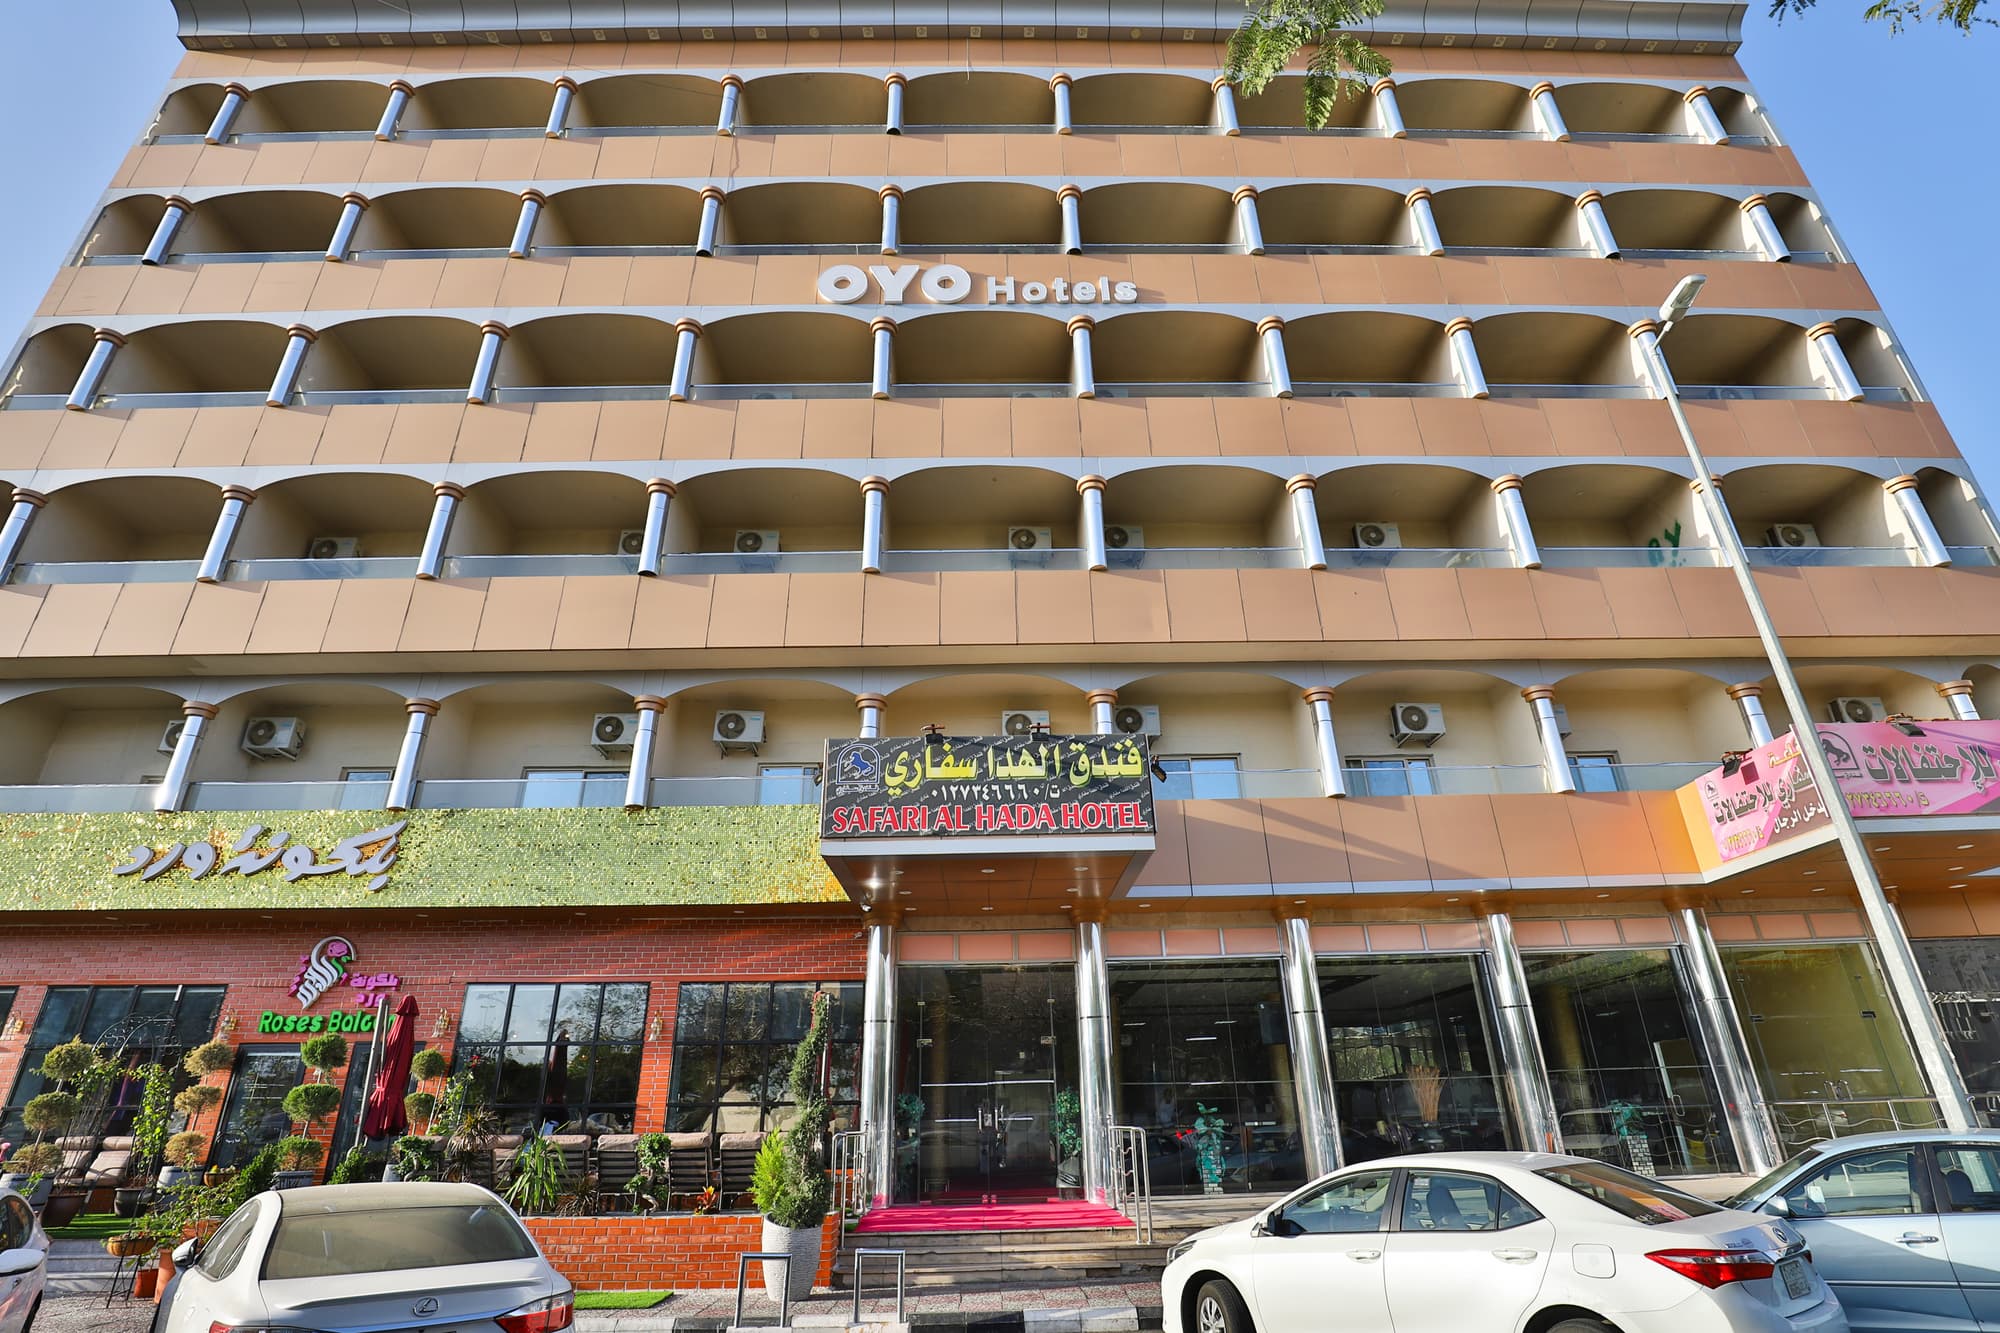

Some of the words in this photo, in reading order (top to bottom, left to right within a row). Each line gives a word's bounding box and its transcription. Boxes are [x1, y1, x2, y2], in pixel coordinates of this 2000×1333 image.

[817, 264, 972, 304] OYO
[986, 275, 1138, 304] Hotels
[884, 742, 978, 796] سفاري
[986, 743, 1062, 779] الهدا
[1069, 738, 1144, 787] فندق
[832, 805, 928, 833] SAFARI
[934, 804, 970, 832] AL
[975, 803, 1056, 831] HADA
[1060, 801, 1149, 829] HOTEL
[112, 841, 217, 882] ورد
[258, 1010, 324, 1033] Roses
